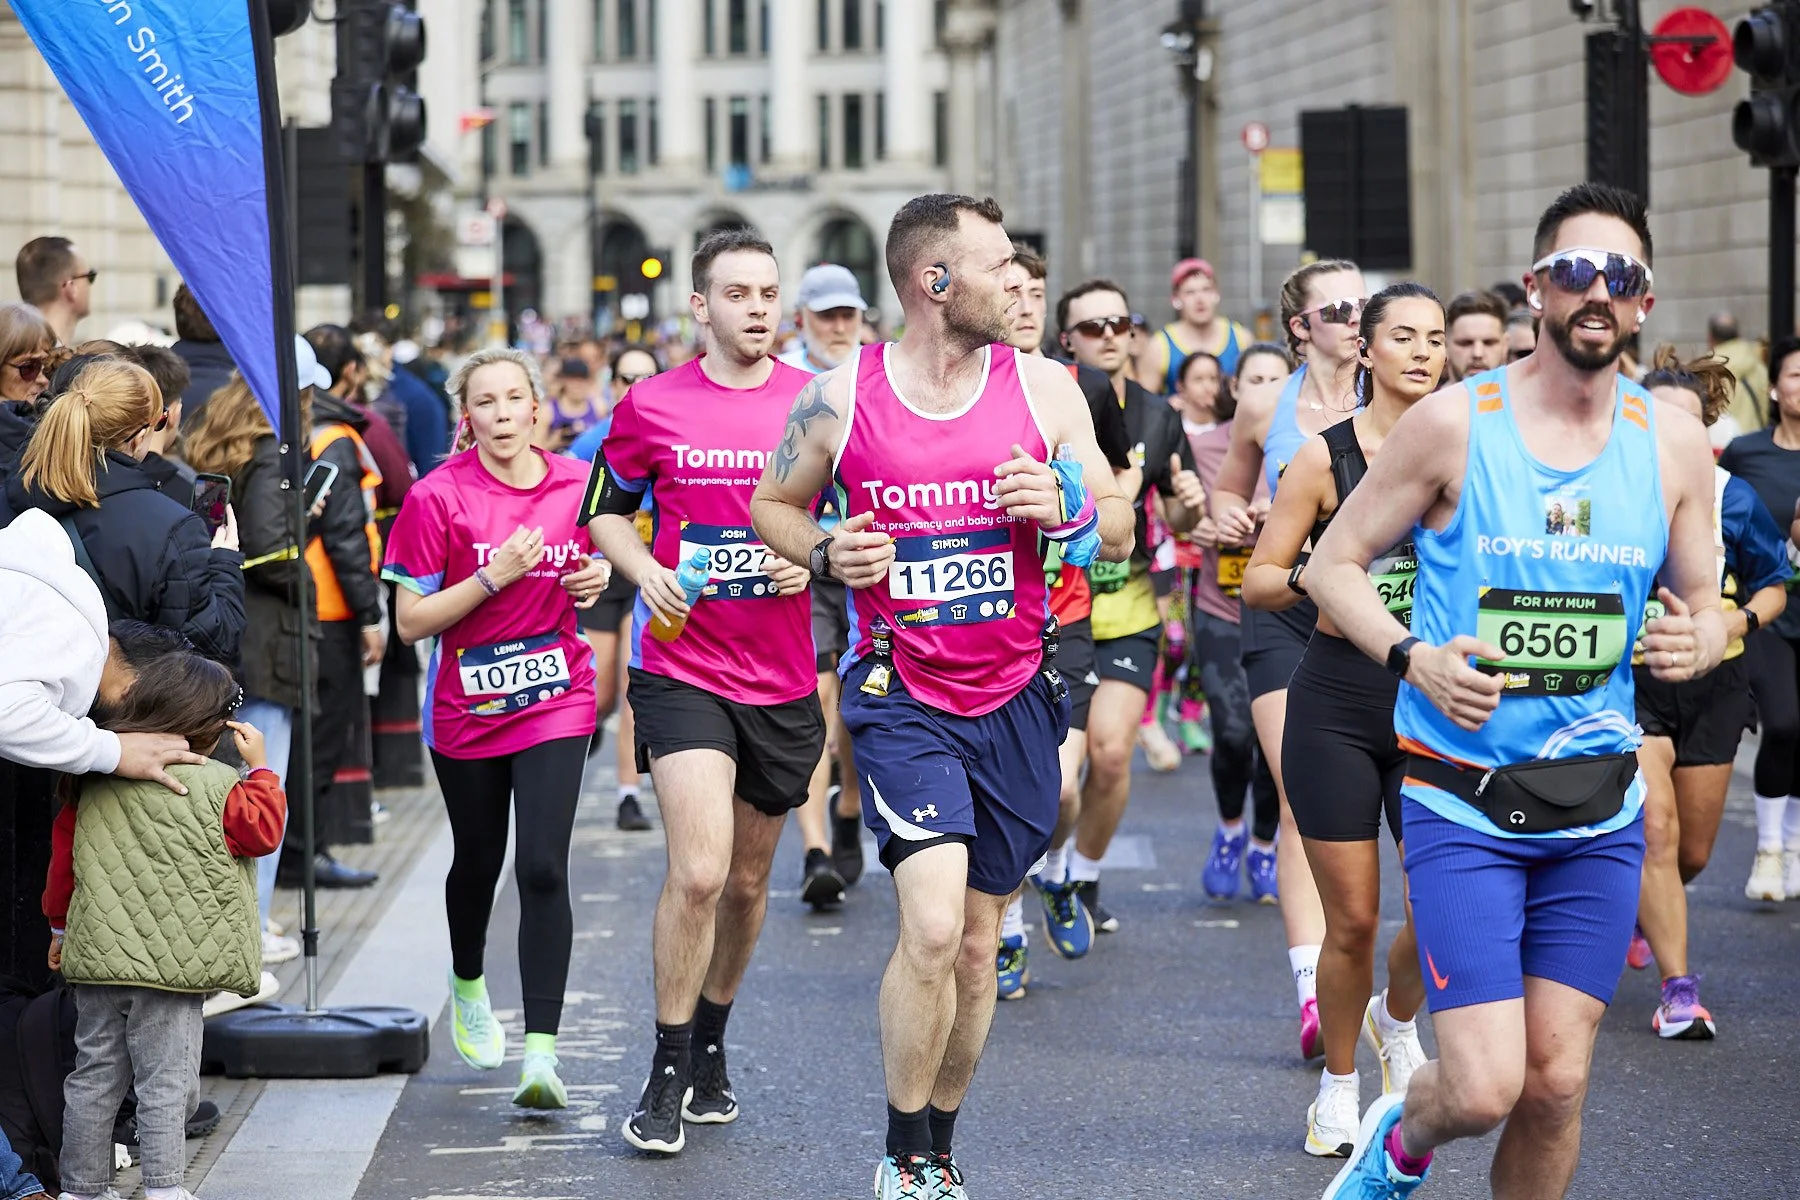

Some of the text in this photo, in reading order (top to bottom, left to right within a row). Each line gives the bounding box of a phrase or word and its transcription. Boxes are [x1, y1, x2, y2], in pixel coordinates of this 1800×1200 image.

[101, 0, 195, 124] n Smith
[688, 478, 733, 487] pregnancy
[734, 477, 751, 486] and
[872, 521, 887, 531] The
[888, 520, 942, 532] pregnancy
[945, 517, 966, 529] and
[967, 514, 994, 528] baby
[720, 529, 747, 539] JOSH
[931, 537, 969, 550] SIMON
[1477, 534, 1646, 568] ROY'S RUNNER
[899, 556, 1007, 595] 11266
[1229, 561, 1248, 579] 3
[1513, 595, 1596, 609] FOR MY MUM
[493, 641, 526, 656] LENKA
[1500, 621, 1598, 659] 6561
[470, 654, 559, 690] 10783
